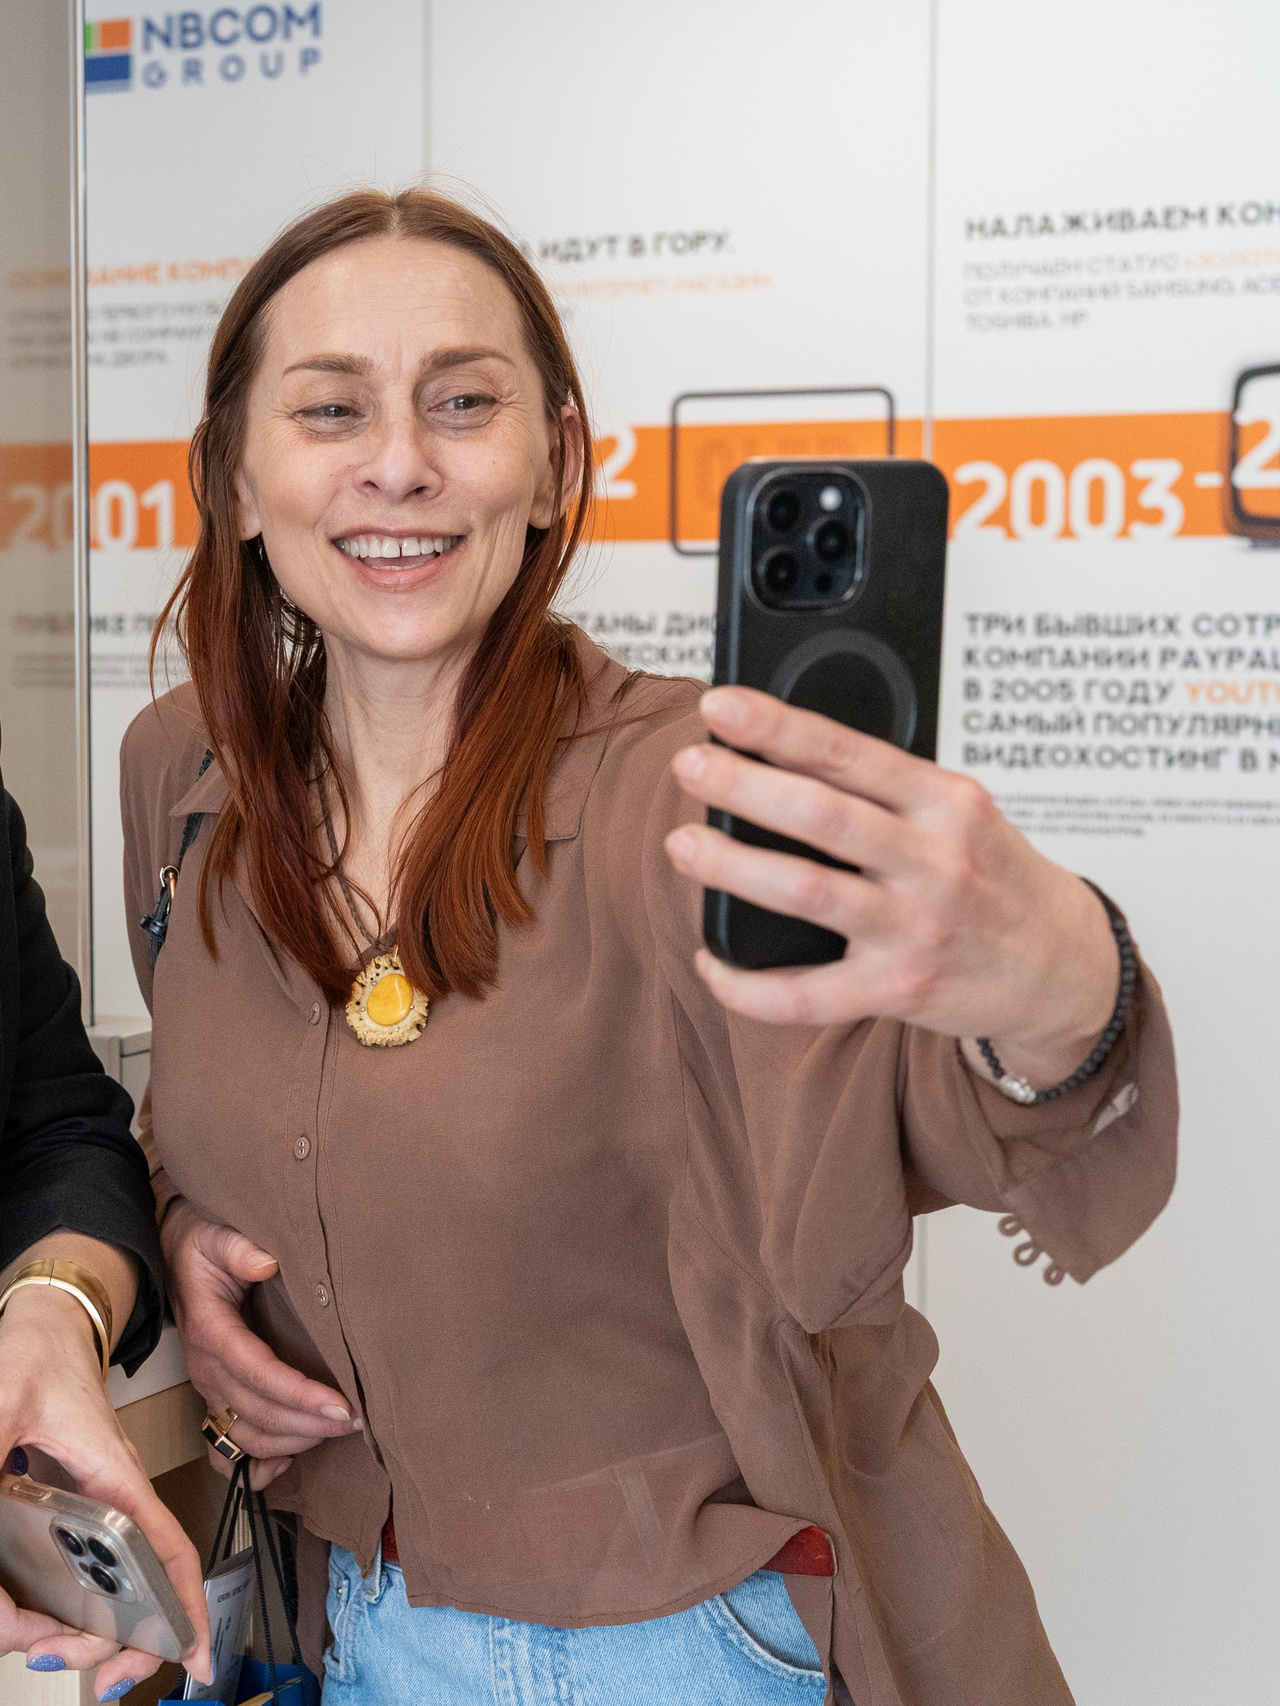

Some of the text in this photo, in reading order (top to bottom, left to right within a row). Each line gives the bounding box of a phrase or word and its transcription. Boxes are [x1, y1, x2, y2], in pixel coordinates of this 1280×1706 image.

[142, 2, 322, 54] NBCOM
[141, 47, 322, 88] GROUP
[965, 202, 1209, 241] НАЛАЖИВАЕМ
[629, 233, 644, 257] В
[966, 611, 1026, 636] ТРИ
[1033, 612, 1182, 639] БЫВШИХ
[963, 645, 1150, 671] КОМПАНИИ
[963, 678, 1280, 707] В 2005 ГОДУ YOUT
[963, 708, 1086, 737] САМЫЙ
[963, 743, 1228, 771] ВИДЕОХОСТИНГ
[1238, 748, 1259, 773] В
